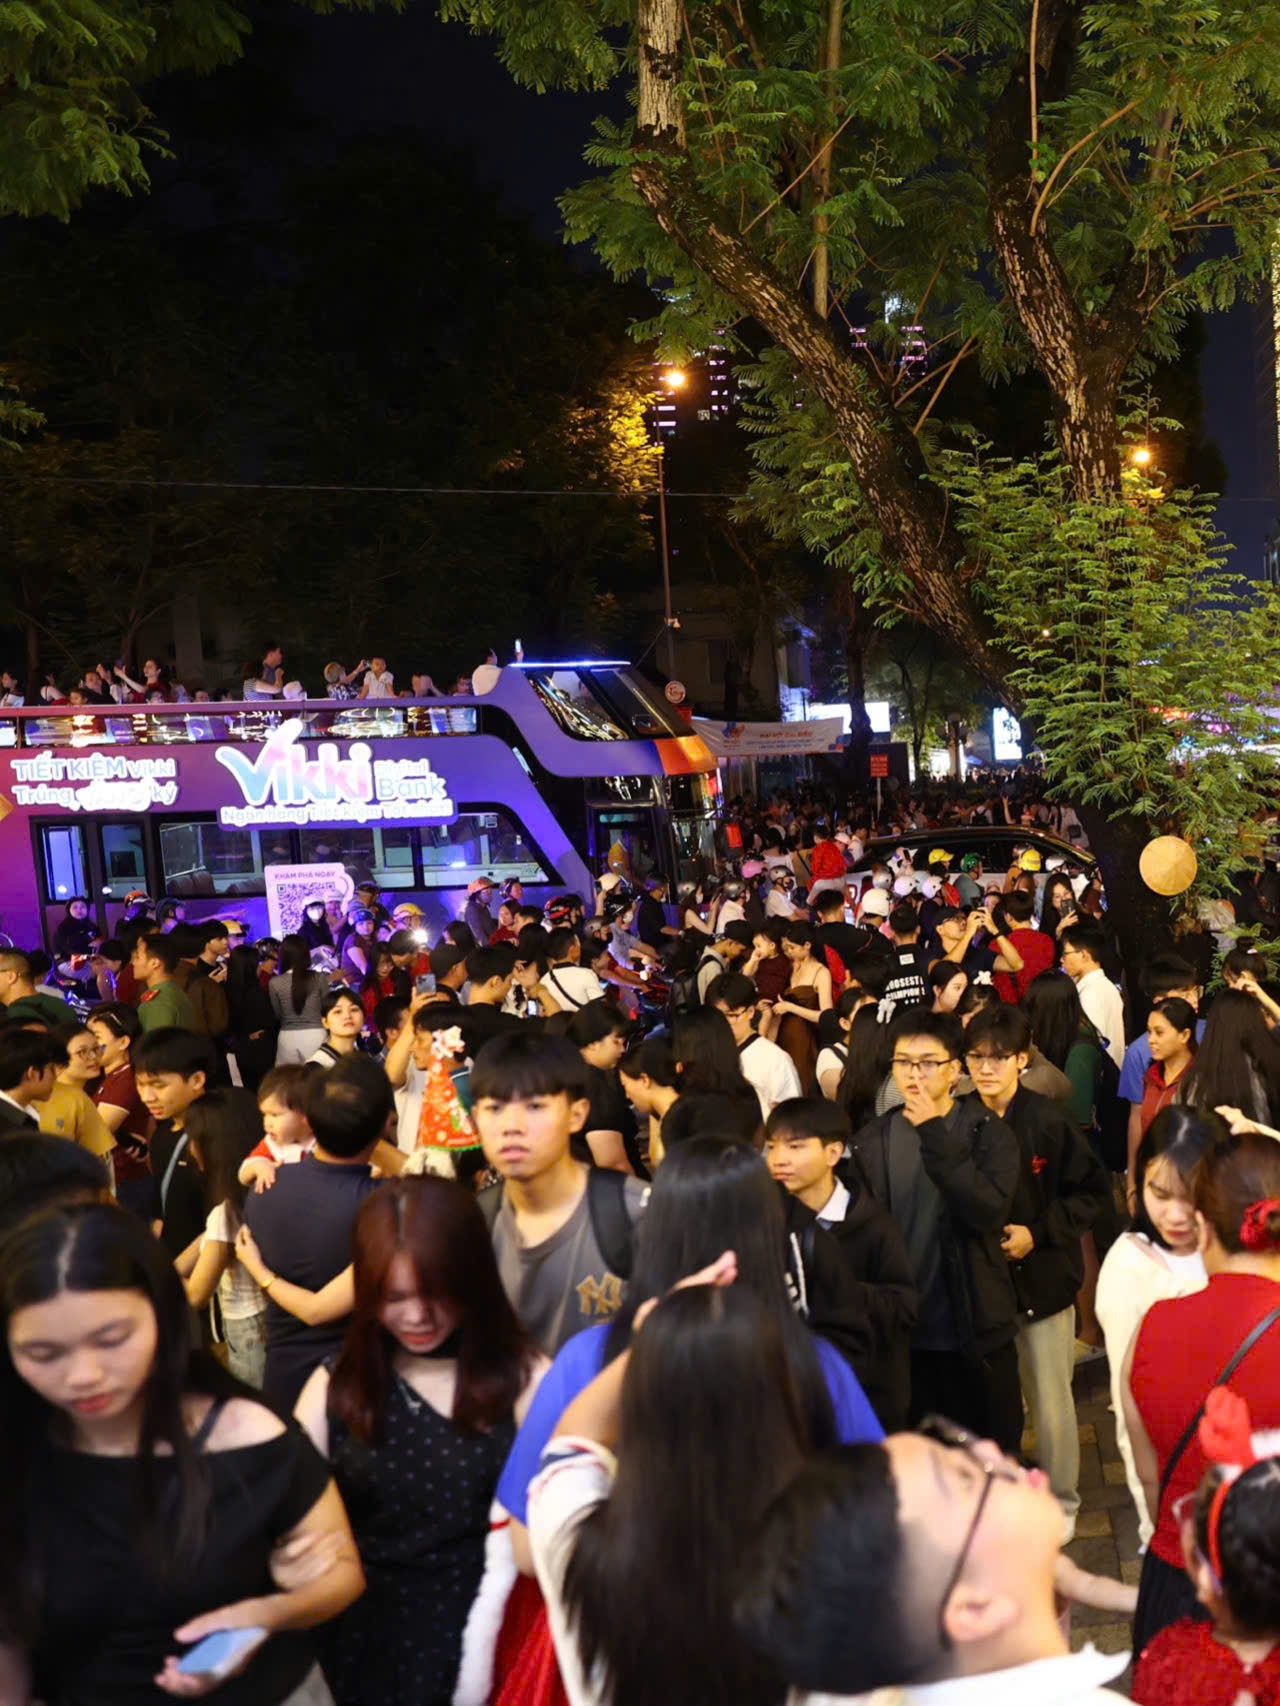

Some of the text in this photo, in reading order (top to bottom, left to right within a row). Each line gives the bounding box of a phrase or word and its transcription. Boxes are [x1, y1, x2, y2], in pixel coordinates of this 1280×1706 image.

[216, 718, 371, 804] Vikki
[378, 776, 444, 798] Bank
[576, 1271, 623, 1315] NY
